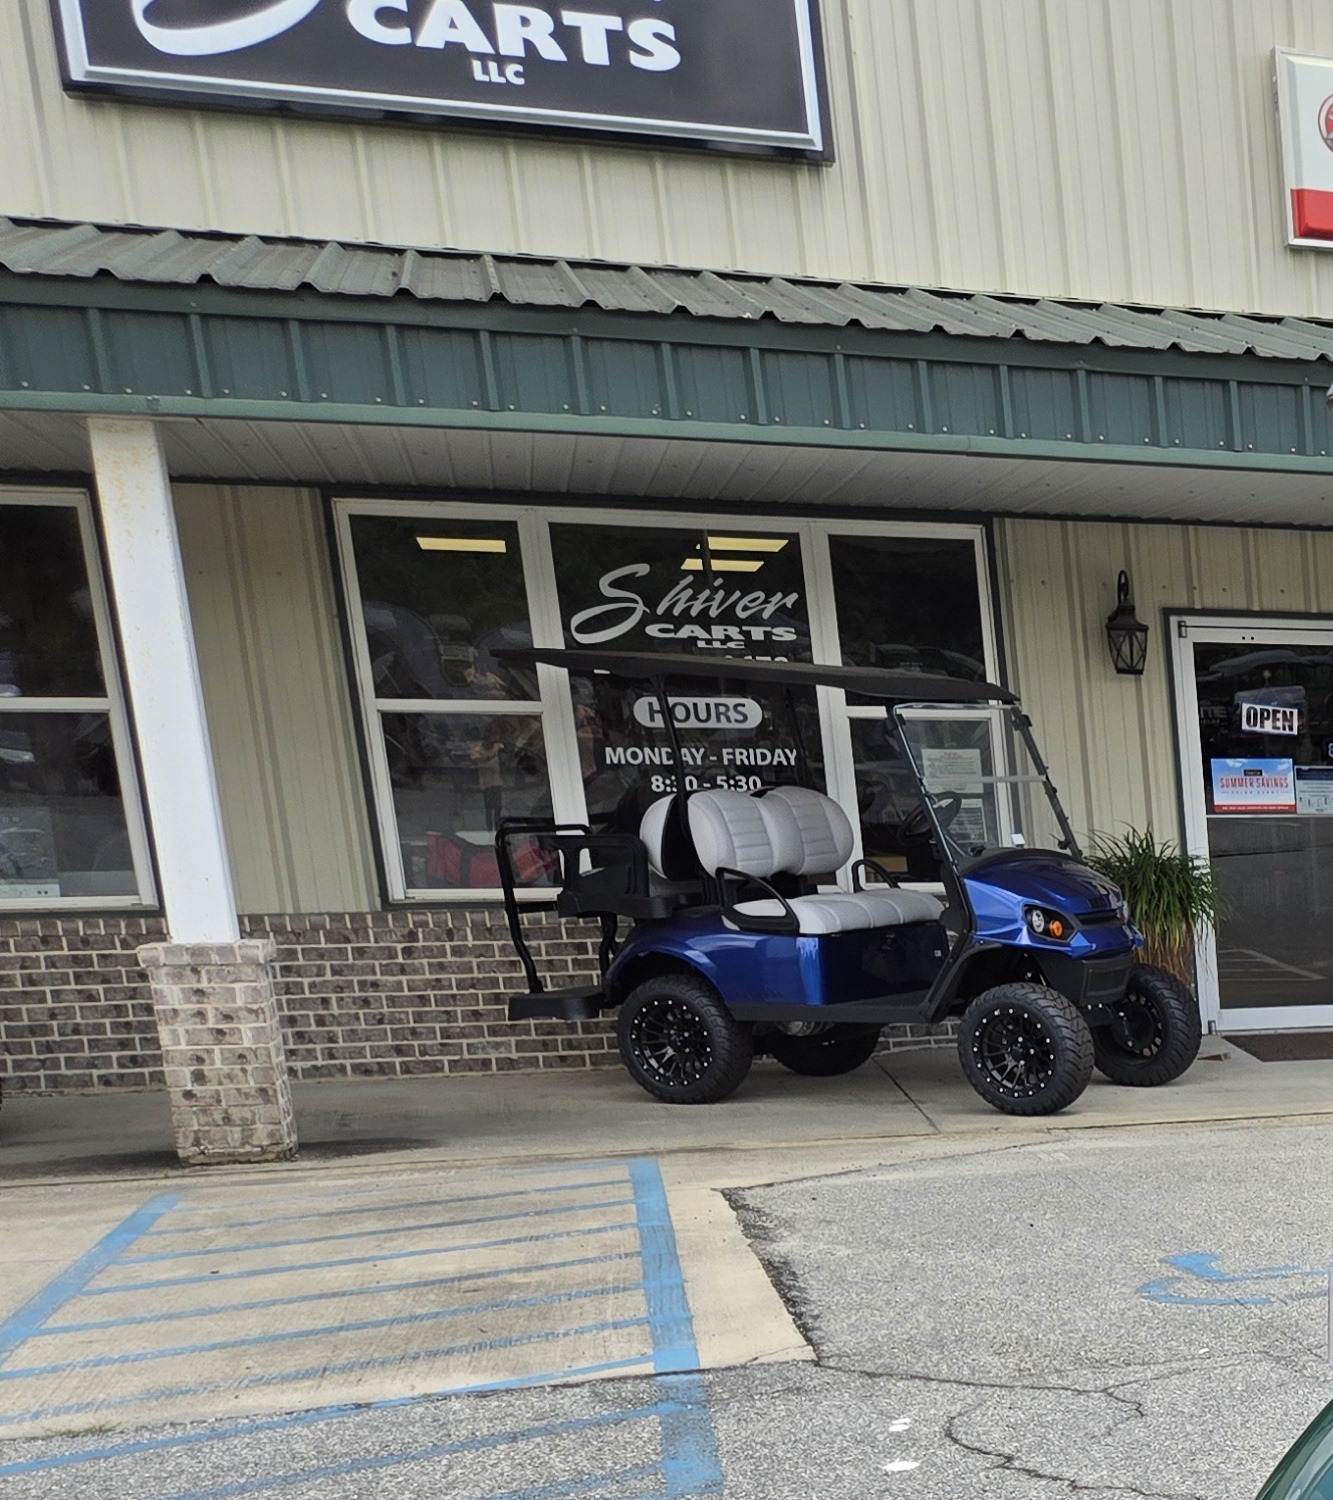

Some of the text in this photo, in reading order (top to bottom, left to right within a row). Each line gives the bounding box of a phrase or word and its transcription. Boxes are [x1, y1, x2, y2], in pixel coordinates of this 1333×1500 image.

[345, 0, 681, 72] CARTS
[472, 58, 525, 85] LLC
[570, 563, 799, 645] Shiver
[645, 623, 798, 642] CARTS
[696, 640, 746, 649] LLC
[1245, 705, 1294, 732] OPEN
[722, 748, 797, 766] FRIDAY
[716, 776, 763, 792] 5:30
[1220, 777, 1289, 789] SUMMER SAVINGS
